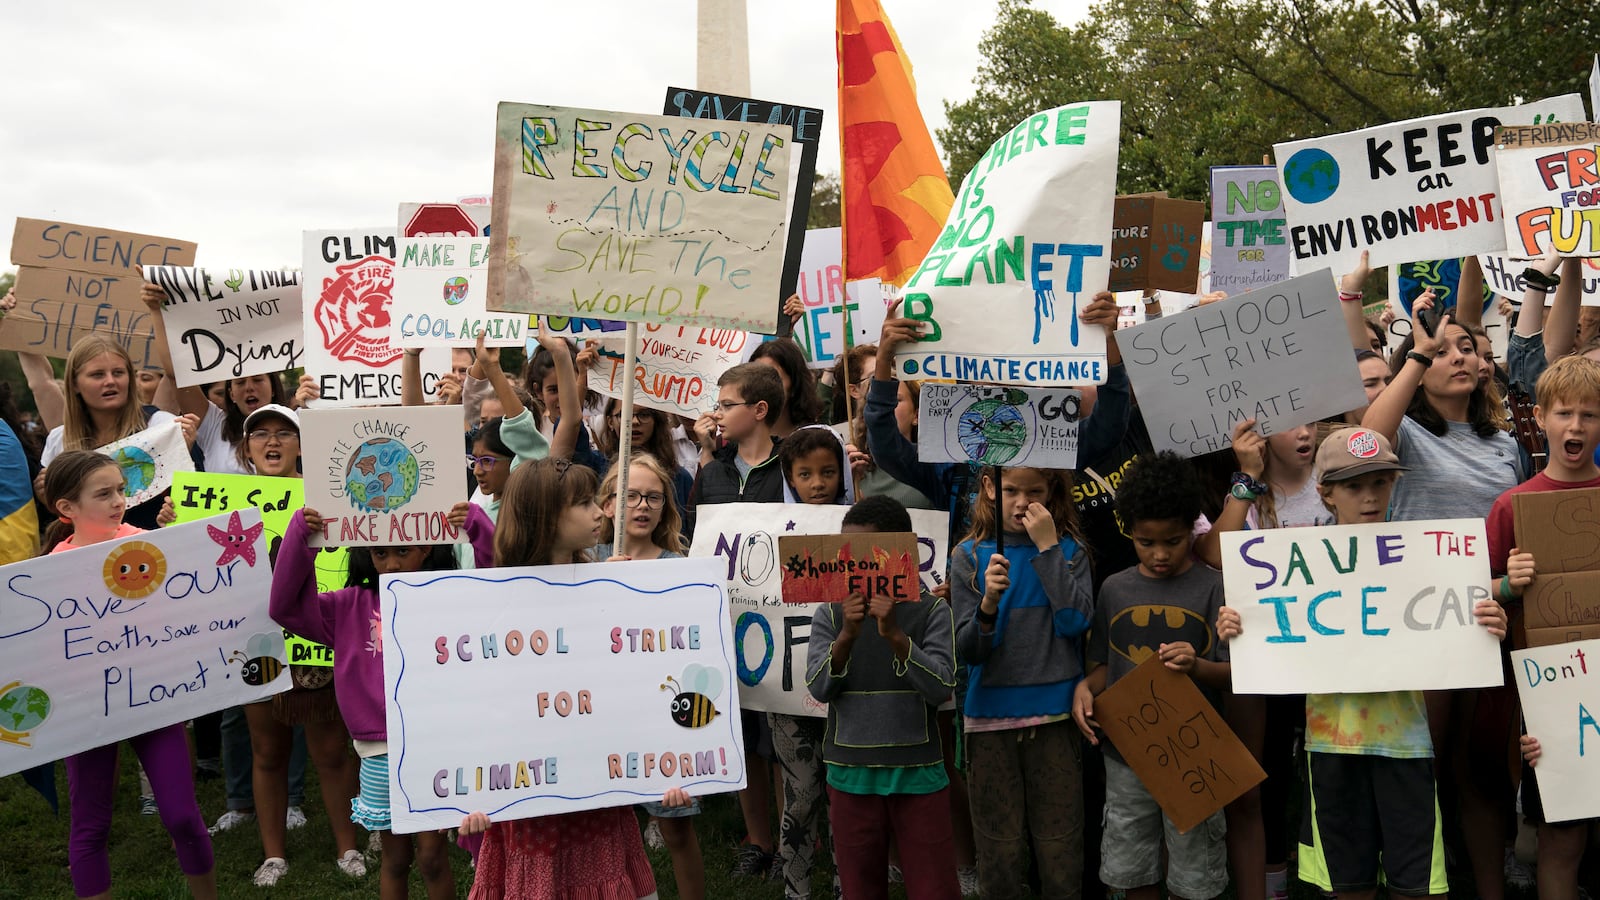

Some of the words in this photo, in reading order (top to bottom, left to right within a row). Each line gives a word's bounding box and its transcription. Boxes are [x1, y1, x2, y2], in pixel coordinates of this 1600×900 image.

[674, 91, 760, 123] SAVE
[767, 104, 820, 141] ME
[966, 105, 1090, 186] THERE
[1366, 116, 1503, 181] KEEP
[1501, 123, 1600, 147] #FRIDAYSFO
[520, 116, 785, 201] RECYCLE
[957, 175, 987, 221] IS
[1226, 179, 1281, 215] NO
[1416, 170, 1453, 193] an
[585, 185, 687, 233] AND
[1290, 192, 1504, 261] ENVIRONMENT
[38, 225, 184, 269] SCIENCE
[935, 205, 995, 253] NO
[1111, 224, 1149, 240] TURE
[1217, 218, 1287, 248] TIME
[1515, 205, 1600, 257] FUT
[321, 235, 397, 264] CLIM
[402, 242, 455, 268] MAKE
[469, 243, 491, 268] EA
[543, 227, 656, 273] SAVE
[907, 235, 1104, 294] PLANET
[1109, 255, 1139, 270] NDS
[1237, 249, 1265, 263] FOR
[65, 274, 121, 301] NOT
[357, 267, 393, 281] FIRE
[800, 264, 852, 307] UR
[1485, 255, 1527, 293] the
[216, 305, 243, 326] IN
[246, 297, 281, 319] NOT
[400, 313, 456, 339] COOL
[459, 317, 522, 340] AGAIN
[902, 292, 943, 343] B
[1132, 292, 1327, 366] SCHOOL
[355, 342, 391, 353] VOLUNTE
[641, 337, 703, 364] YOURSELF
[791, 302, 860, 364] NET
[180, 328, 305, 377] Dying
[922, 355, 1020, 381] CLIMATE
[1024, 359, 1101, 382] CHANGE
[1170, 331, 1303, 387] STRIKE
[605, 355, 703, 405] TRUMP
[1205, 379, 1248, 408] FOR
[929, 398, 951, 409] COW
[1037, 394, 1081, 424] GO
[1168, 388, 1305, 445] CLIMATE
[353, 419, 410, 441] CHANGE
[410, 440, 429, 454] IS
[1039, 424, 1078, 438] VEGAN
[1189, 420, 1273, 456] CHAE
[328, 439, 352, 499] CLIMATE
[418, 460, 436, 489] REAL
[180, 485, 229, 511] It's
[246, 489, 292, 513] Sad
[321, 513, 379, 543] TAKE
[388, 511, 460, 543] ACTION
[1239, 534, 1406, 591] SAVE
[1423, 530, 1477, 557] THE
[731, 596, 759, 611] ruining
[848, 574, 908, 600] FIRE
[0, 573, 147, 640] Save
[1258, 586, 1391, 644] ICE
[1402, 585, 1489, 631] CAP
[63, 624, 159, 660] Earth,
[208, 615, 248, 633] our
[291, 643, 334, 663] DATE
[435, 627, 570, 666] SCHOOL
[610, 624, 702, 654] STRIKE
[1522, 647, 1589, 689] Don't
[536, 689, 594, 719] FOR
[432, 756, 559, 799] CLIMATE
[607, 746, 729, 780] REFORM!
[1181, 757, 1238, 800] We
